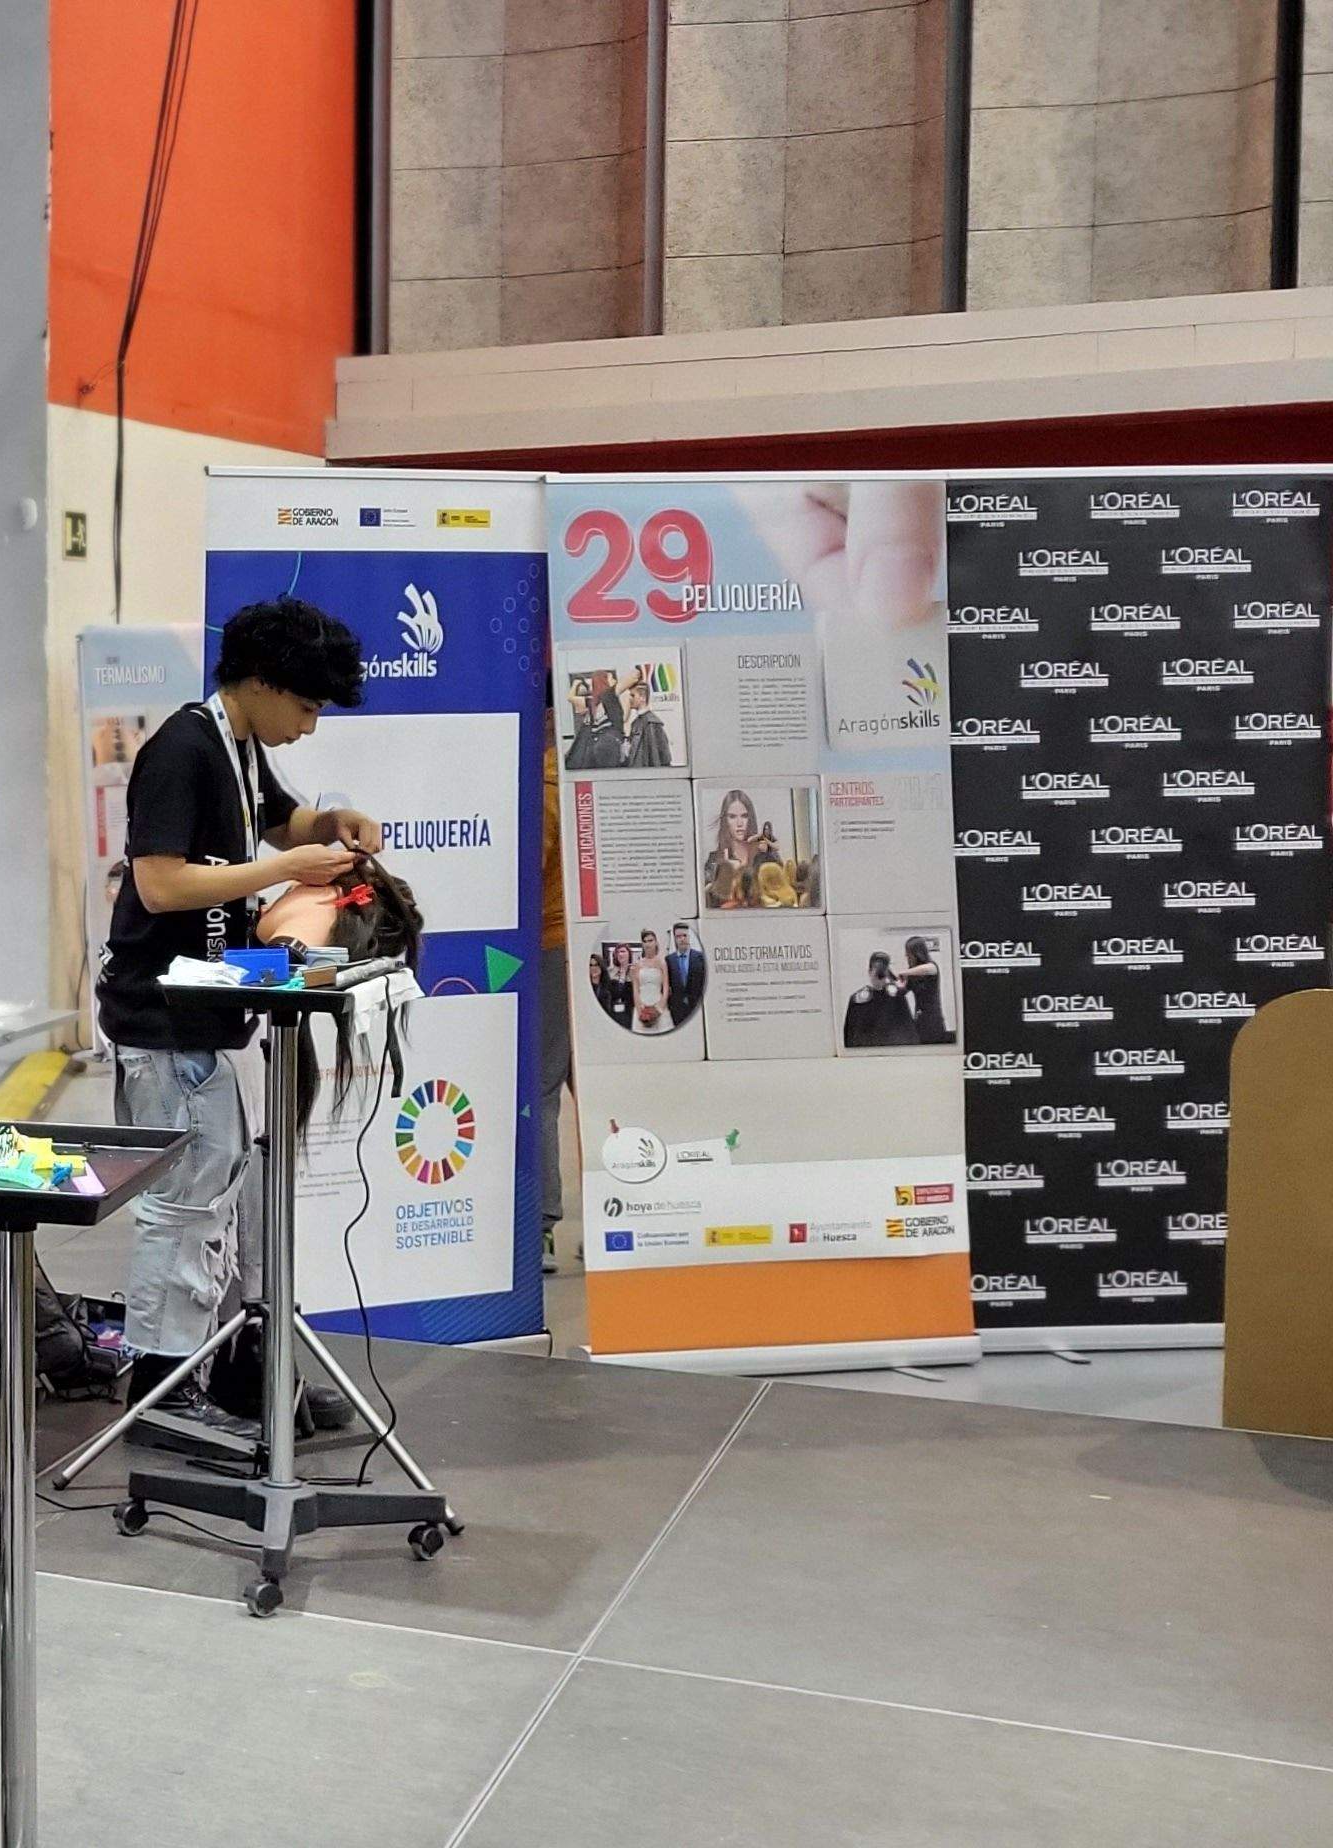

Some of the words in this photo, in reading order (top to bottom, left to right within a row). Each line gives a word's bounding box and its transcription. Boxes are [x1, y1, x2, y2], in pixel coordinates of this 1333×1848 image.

[947, 494, 1038, 513] L'ORÉAL
[1090, 492, 1180, 510] L'ORÉAL
[1233, 490, 1321, 508] L'ORÉAL
[293, 508, 333, 517] GOBIERNO
[293, 517, 304, 526] DE
[1019, 549, 1108, 567] L'ORÉAL
[1161, 546, 1251, 565] L'ORÉAL
[564, 509, 713, 622] 29
[682, 579, 803, 612] PELUQUERÍA
[947, 606, 1039, 624] L'ORÉAL
[1090, 604, 1180, 622] L'ORÉAL
[1234, 601, 1320, 619] L'ORÉAL
[95, 667, 166, 685] TERMALISMO
[359, 652, 438, 682] gónskills
[1020, 660, 1109, 678] L'ORÉAL
[1162, 658, 1254, 676] L'ORÉAL
[838, 709, 940, 735] Aragónskills
[950, 717, 1040, 735] 'ORÉAL
[1090, 715, 1181, 733] L'ORÉAL
[1235, 712, 1321, 730] L'ORÉAL
[1022, 772, 1110, 790] L'ORÉAL
[1163, 769, 1255, 788] L'ORÉAL
[381, 813, 491, 853] PELUQUERÍA
[578, 793, 596, 870] APLICACIONES
[954, 829, 1040, 847] 'ORÉAL
[1091, 826, 1182, 844] L'ORÉAL
[1236, 823, 1323, 841] L'ORÉAL
[1022, 884, 1112, 901] L'ORÉAL
[1163, 880, 1255, 899] L'ORÉAL
[960, 941, 1041, 959] 'ORÉAL
[1092, 937, 1183, 955] L'ORÉAL
[1236, 934, 1324, 952] L'ORÉAL
[750, 945, 812, 960] FORMATIVOS
[1023, 994, 1113, 1012] L'ORÉAL
[1165, 991, 1256, 1010] L'ORÉAL
[964, 1052, 1043, 1070] ORÉAL
[1094, 1048, 1184, 1067] L'ORÉAL
[1023, 1105, 1115, 1123] L'ORÉAL
[1166, 1101, 1231, 1120] L'ORÉ
[966, 1163, 1044, 1181] ORÉAL
[1096, 1160, 1186, 1178] L'ORÉAL
[396, 1198, 473, 1220] OBJETIVOS
[626, 1202, 653, 1214] hoya
[396, 1222, 408, 1233] DE
[412, 1216, 474, 1232] DESARROLLO
[1026, 1216, 1116, 1235] L'ORÉAL
[1167, 1212, 1228, 1230] L'ORÉ
[396, 1229, 474, 1249] SOSTENIBLE
[823, 1233, 857, 1242] Huesca
[906, 1228, 919, 1238] DE
[971, 1274, 1046, 1292] ORÉAL
[1098, 1270, 1187, 1288] L'ORÉAL
